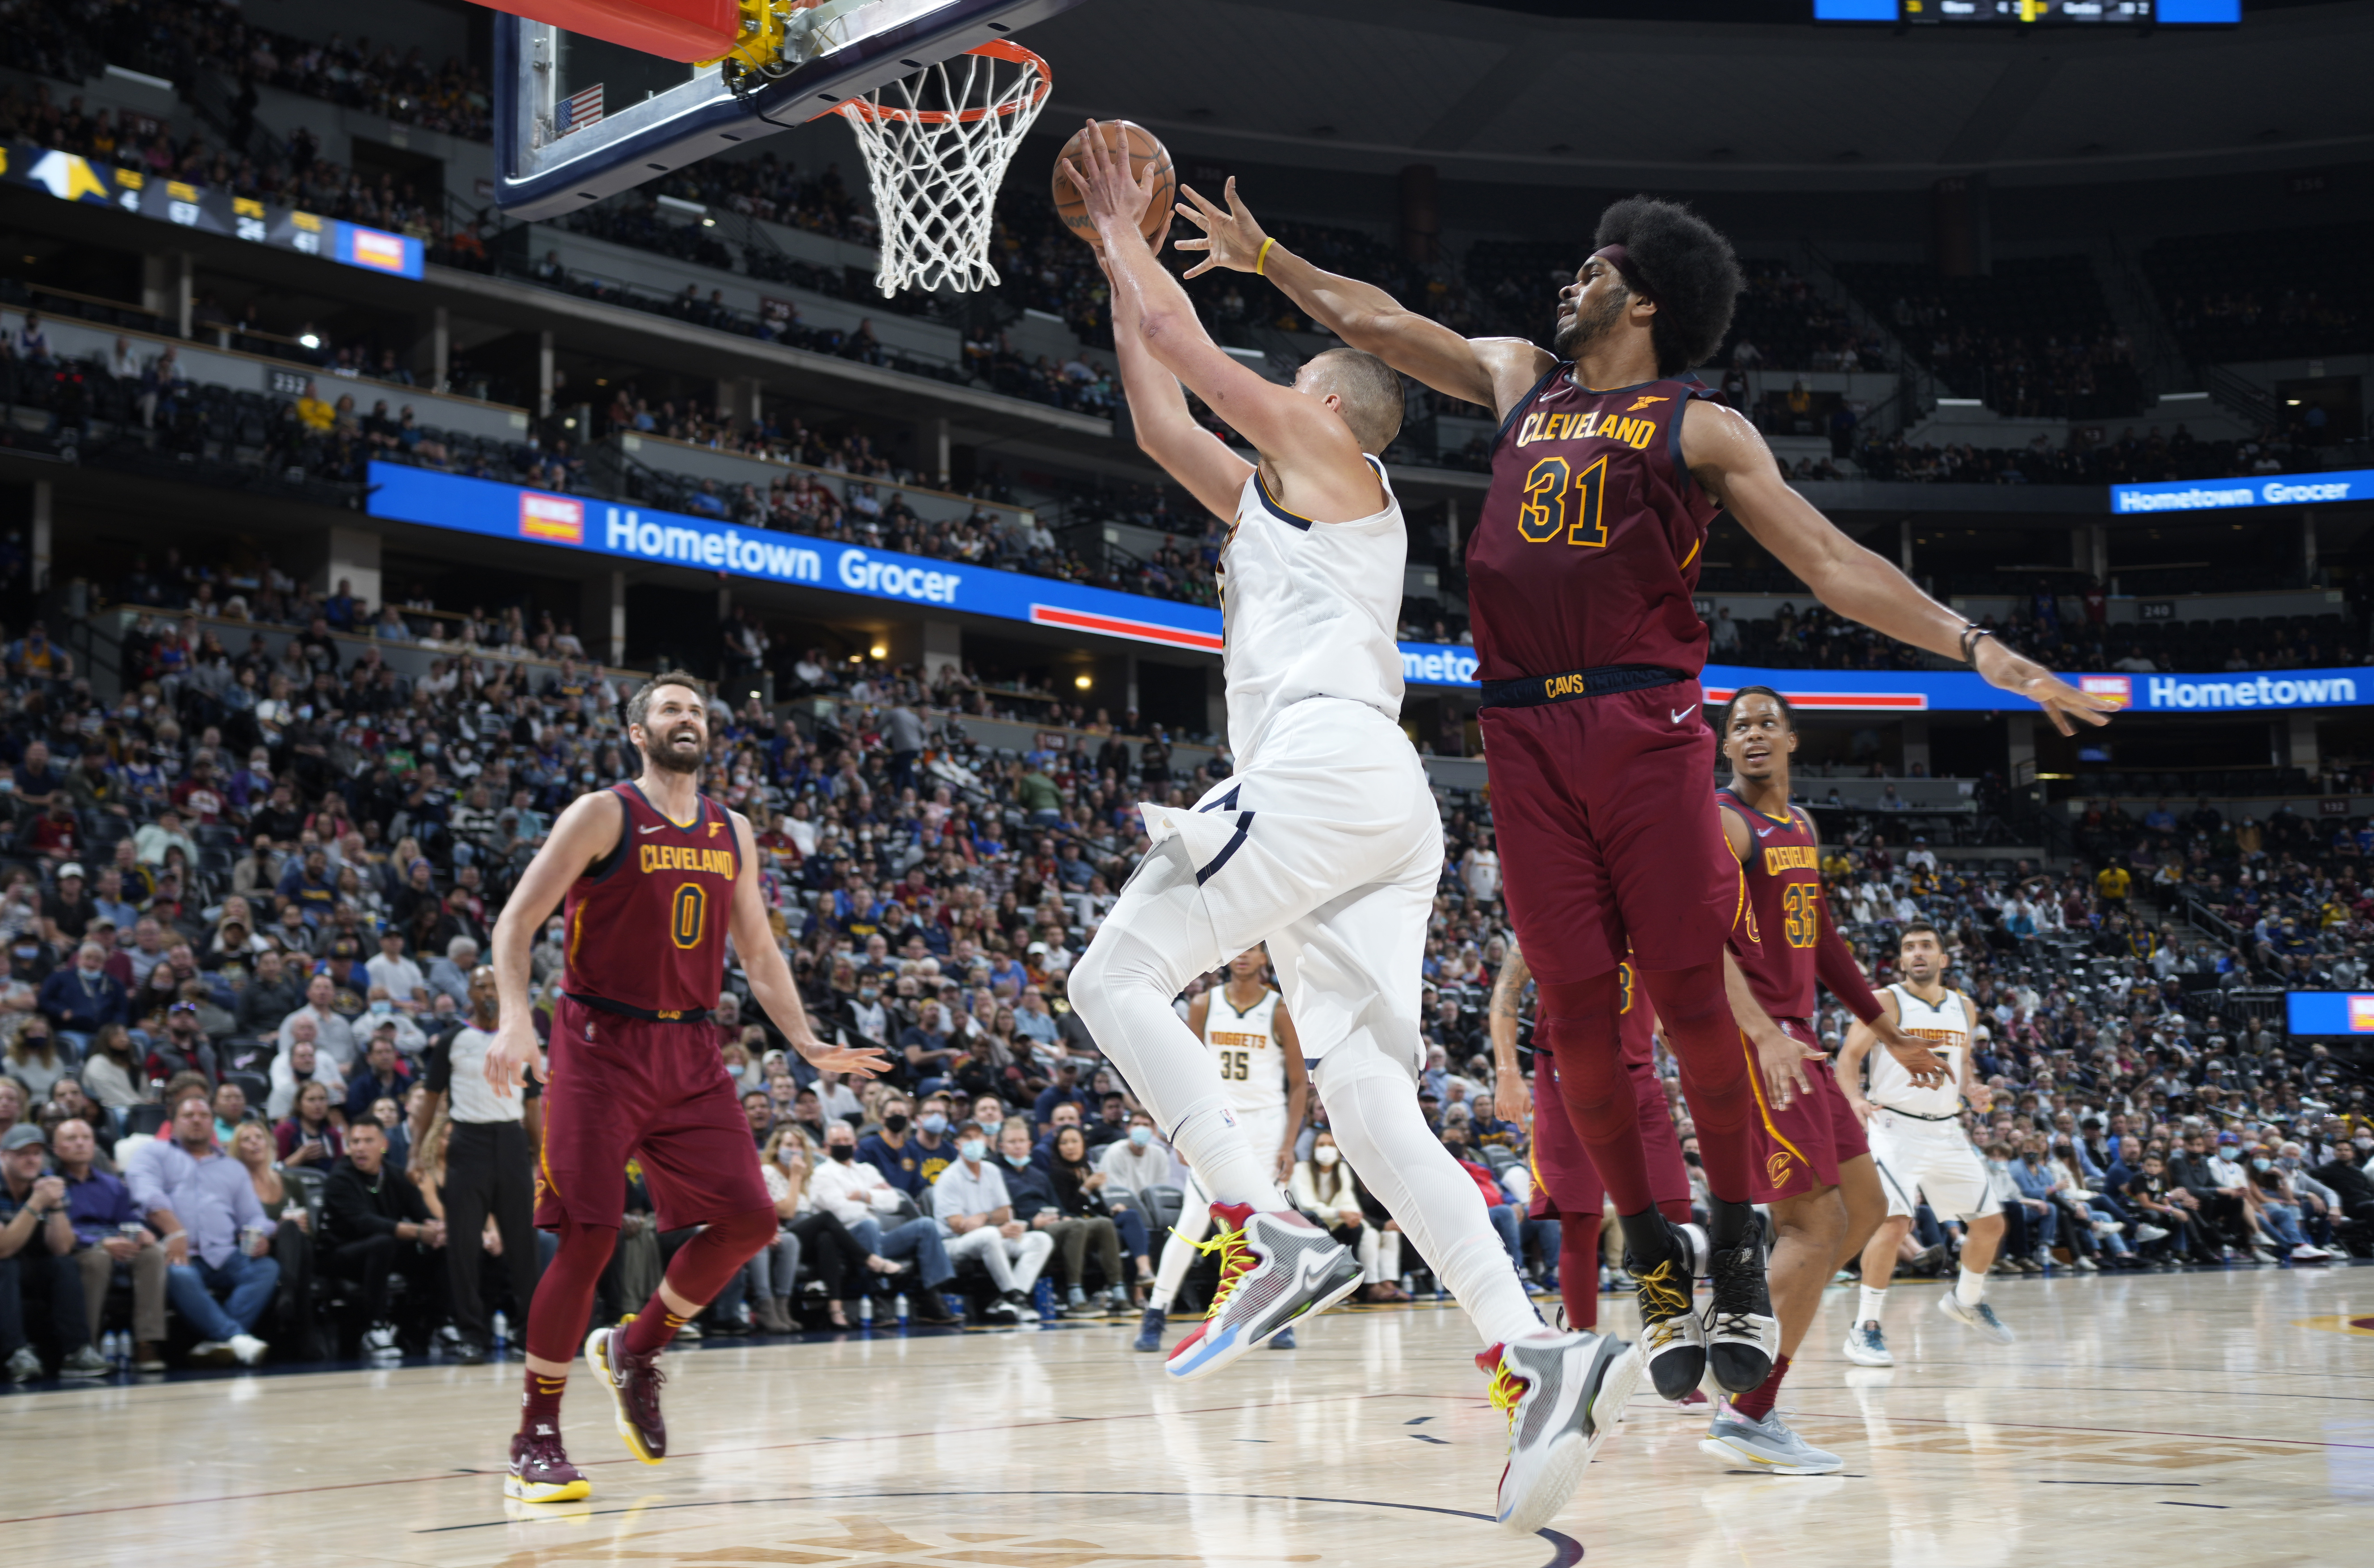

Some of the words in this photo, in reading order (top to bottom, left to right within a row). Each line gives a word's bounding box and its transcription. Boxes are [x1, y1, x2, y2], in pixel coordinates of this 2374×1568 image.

[1516, 410, 1657, 450] CLEVELAND
[1517, 454, 1608, 548] 31
[2119, 488, 2254, 512] Hometown
[2262, 482, 2351, 504] Grocer
[606, 507, 821, 582] Hometown
[837, 548, 962, 604] Grocer
[1695, 600, 1711, 614] 38
[1401, 650, 1480, 683] meto
[1545, 673, 1584, 698] CAVS
[2149, 675, 2356, 708] Hometown
[640, 844, 734, 881] CLEVELAND
[671, 882, 708, 949] 0
[1783, 882, 1821, 948] 35
[1210, 1031, 1267, 1049] NUGGETS
[1220, 1050, 1249, 1081] 35
